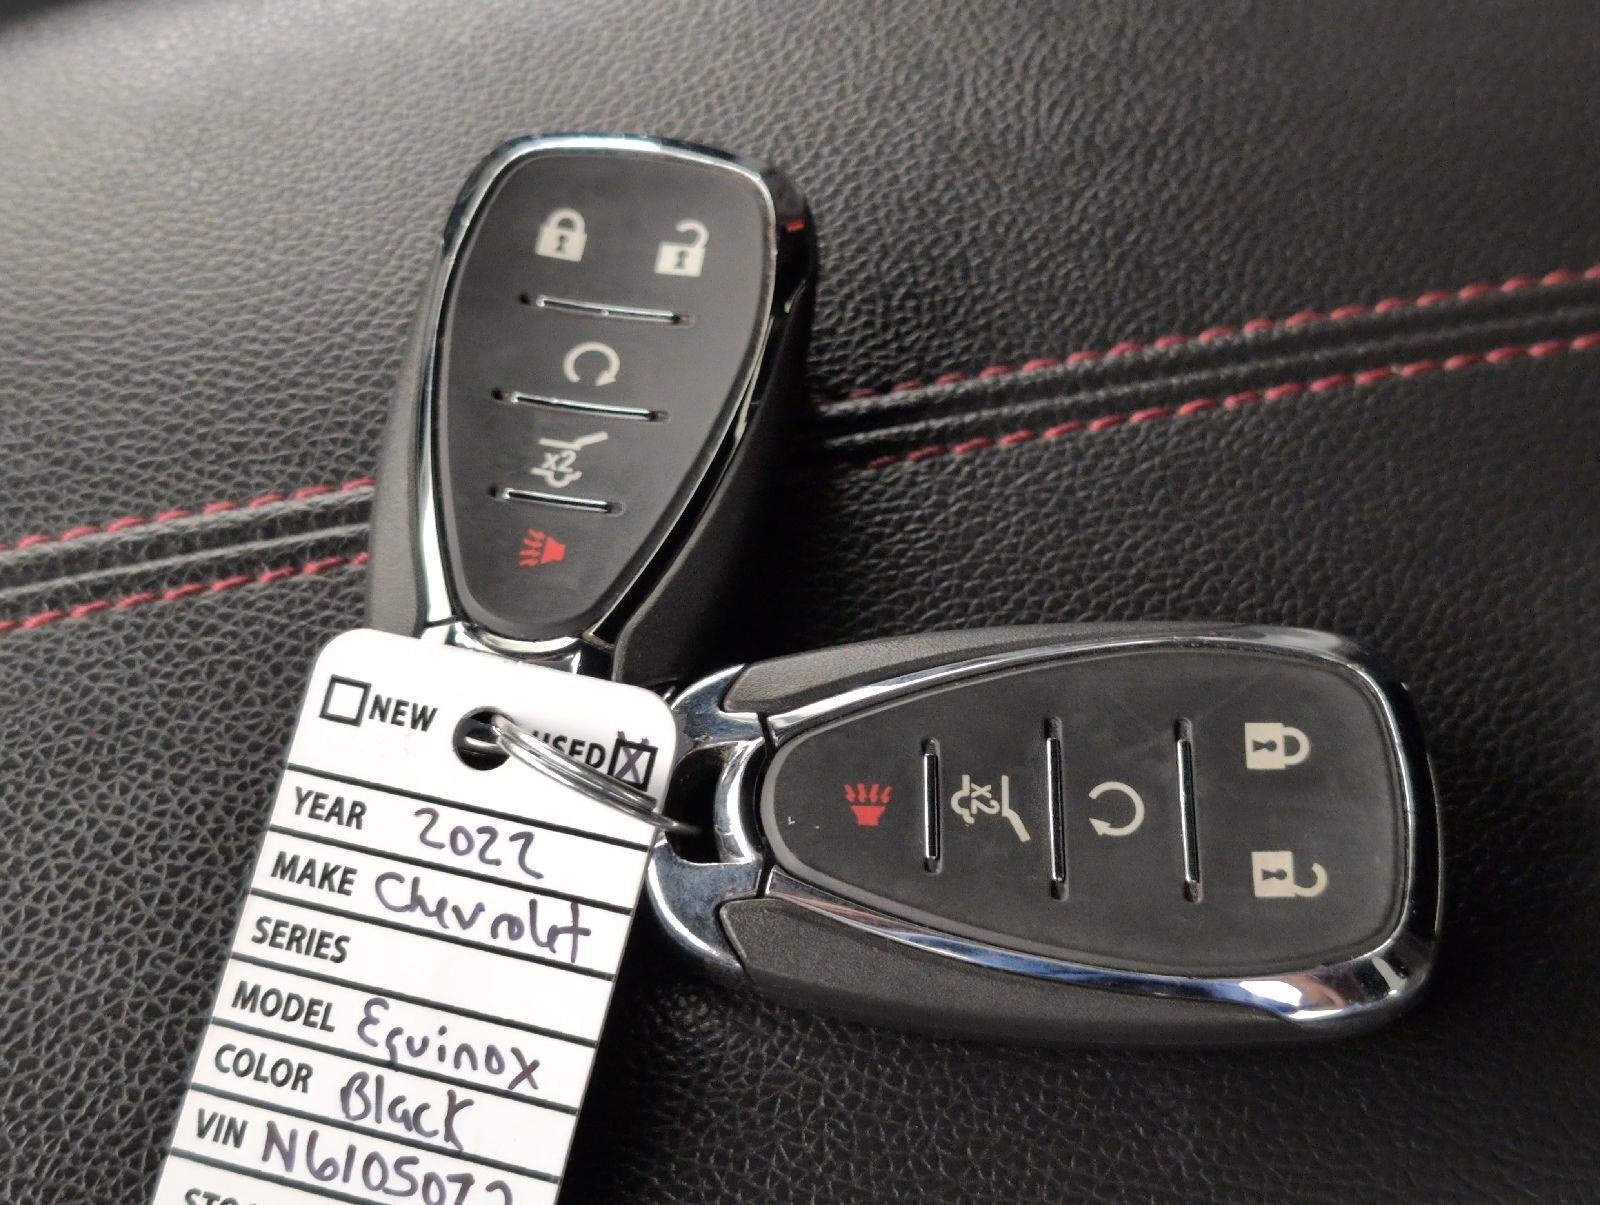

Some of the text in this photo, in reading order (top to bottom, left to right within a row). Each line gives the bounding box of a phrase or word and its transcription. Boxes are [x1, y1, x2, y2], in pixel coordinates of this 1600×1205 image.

[370, 695, 437, 732] NEW
[295, 787, 367, 830] YEAR
[414, 807, 544, 880] 2022
[270, 851, 358, 896] MAKE
[250, 915, 352, 964] SERIES
[375, 872, 592, 963] Chevrolet
[231, 980, 336, 1033] MODEL
[214, 1043, 314, 1094] COLOR
[357, 997, 541, 1091] Equinox
[197, 1108, 248, 1149] VIN
[340, 1071, 474, 1151] Black
